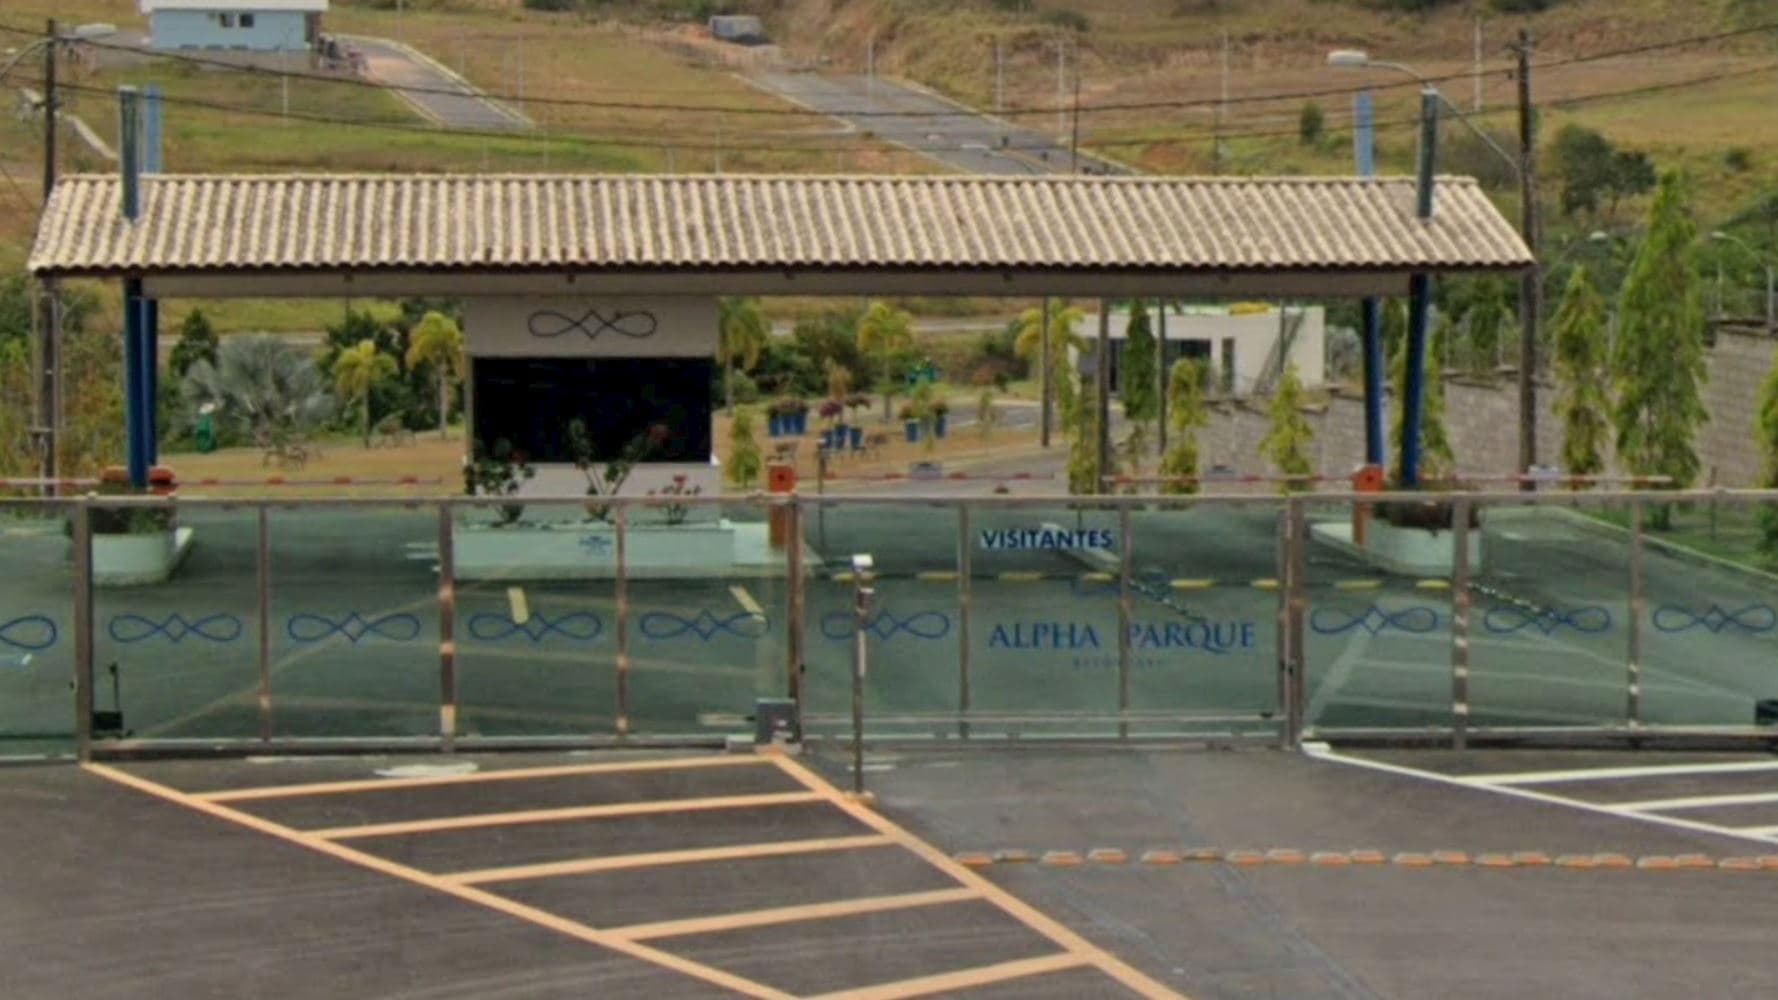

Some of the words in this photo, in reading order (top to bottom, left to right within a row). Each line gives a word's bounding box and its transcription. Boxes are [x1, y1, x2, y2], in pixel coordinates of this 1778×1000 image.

[982, 529, 1113, 548] VISITANTES
[989, 622, 1099, 649] ALPHA
[1125, 621, 1256, 655] PARQUE
